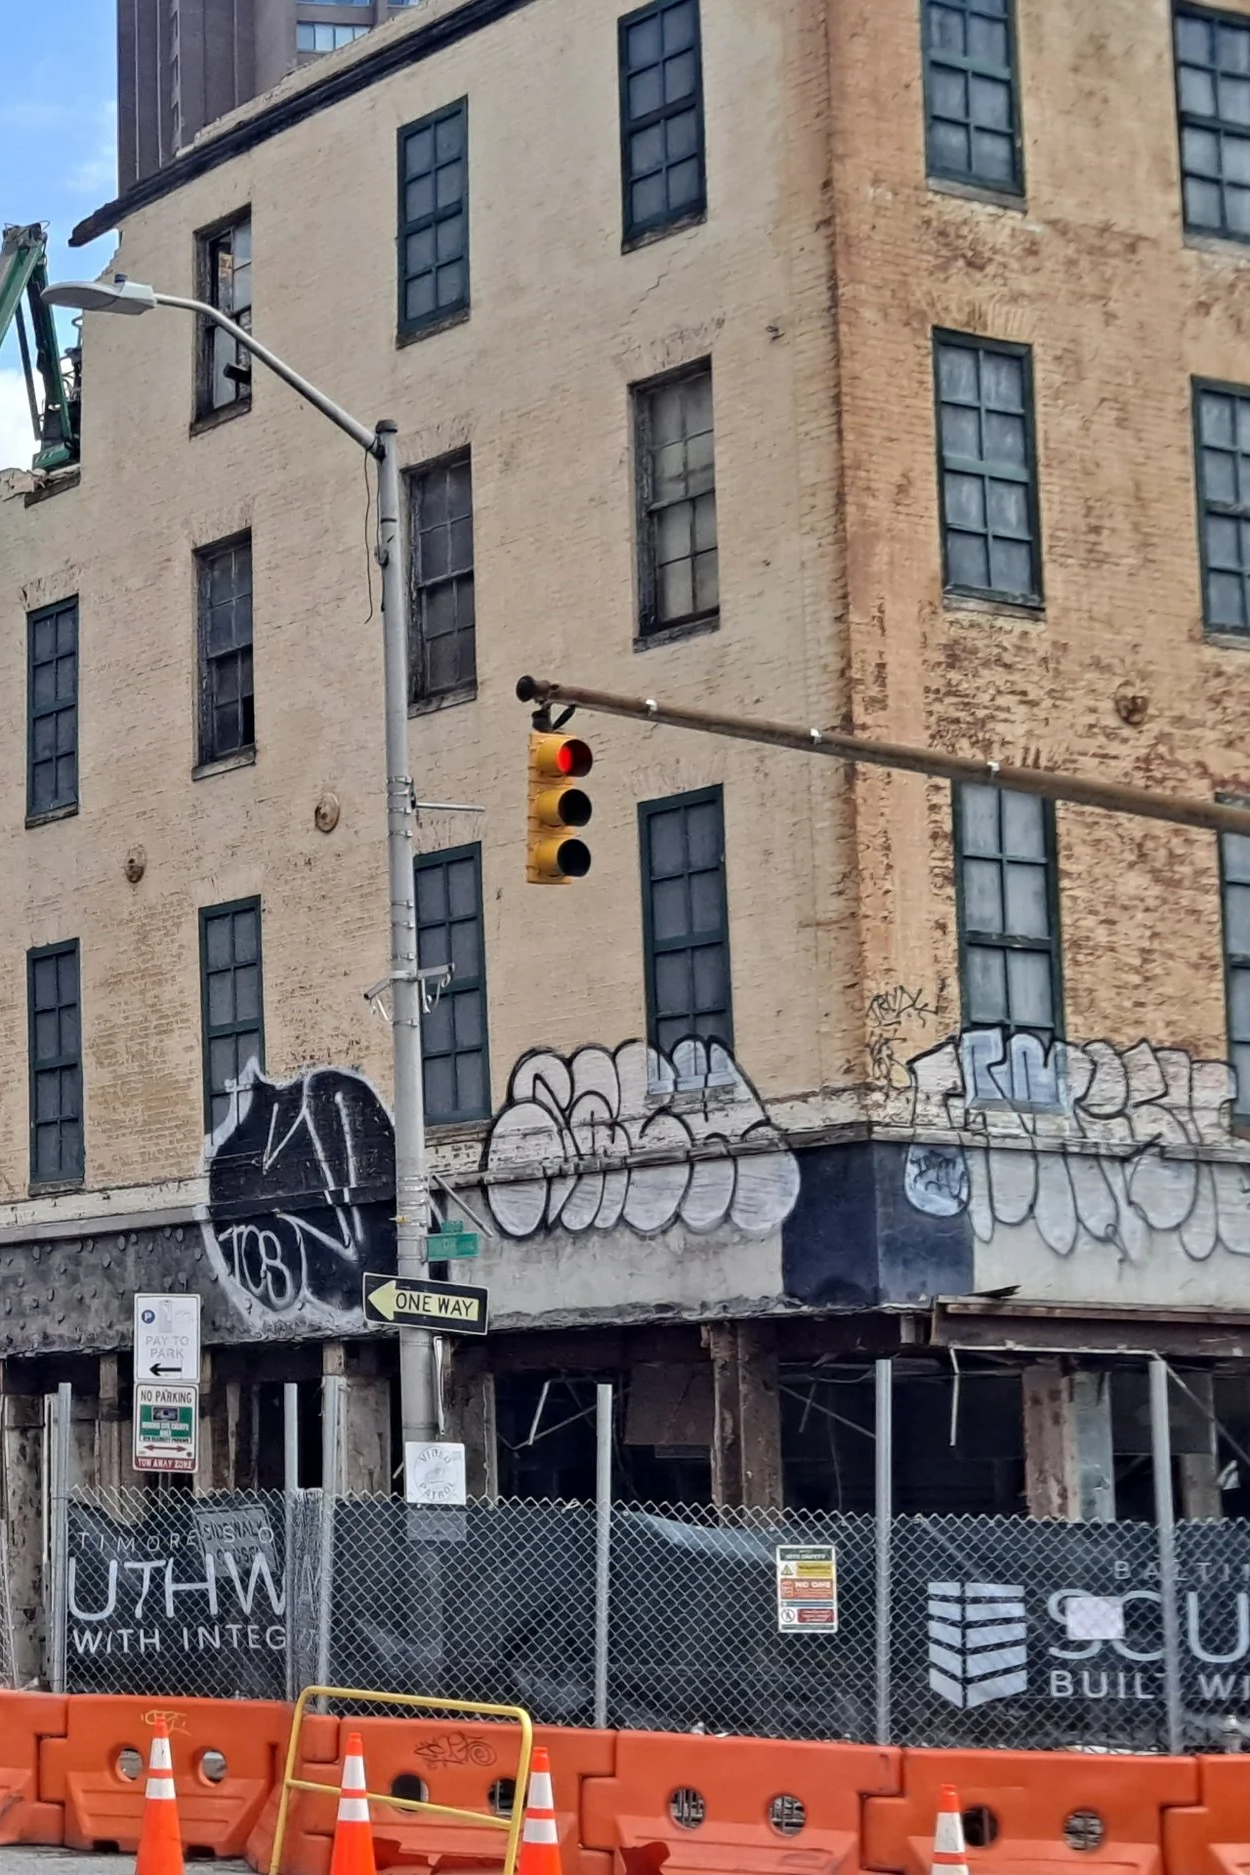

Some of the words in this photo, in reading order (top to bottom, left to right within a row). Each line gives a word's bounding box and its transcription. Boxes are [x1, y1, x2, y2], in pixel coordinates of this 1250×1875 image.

[395, 1292, 432, 1312] ONE
[438, 1297, 473, 1317] WAY
[146, 1336, 167, 1346] PAY
[172, 1336, 189, 1346] TO
[150, 1348, 184, 1359] PARK
[140, 1390, 153, 1402] NO
[155, 1391, 192, 1403] PARKING
[419, 1448, 452, 1464] VIDEO
[138, 1458, 151, 1467] TOW
[152, 1459, 173, 1468] AWAY
[174, 1460, 193, 1469] ZONE
[419, 1482, 455, 1499] PATROL
[73, 1628, 160, 1654] WITH
[183, 1624, 286, 1651] INTEG
